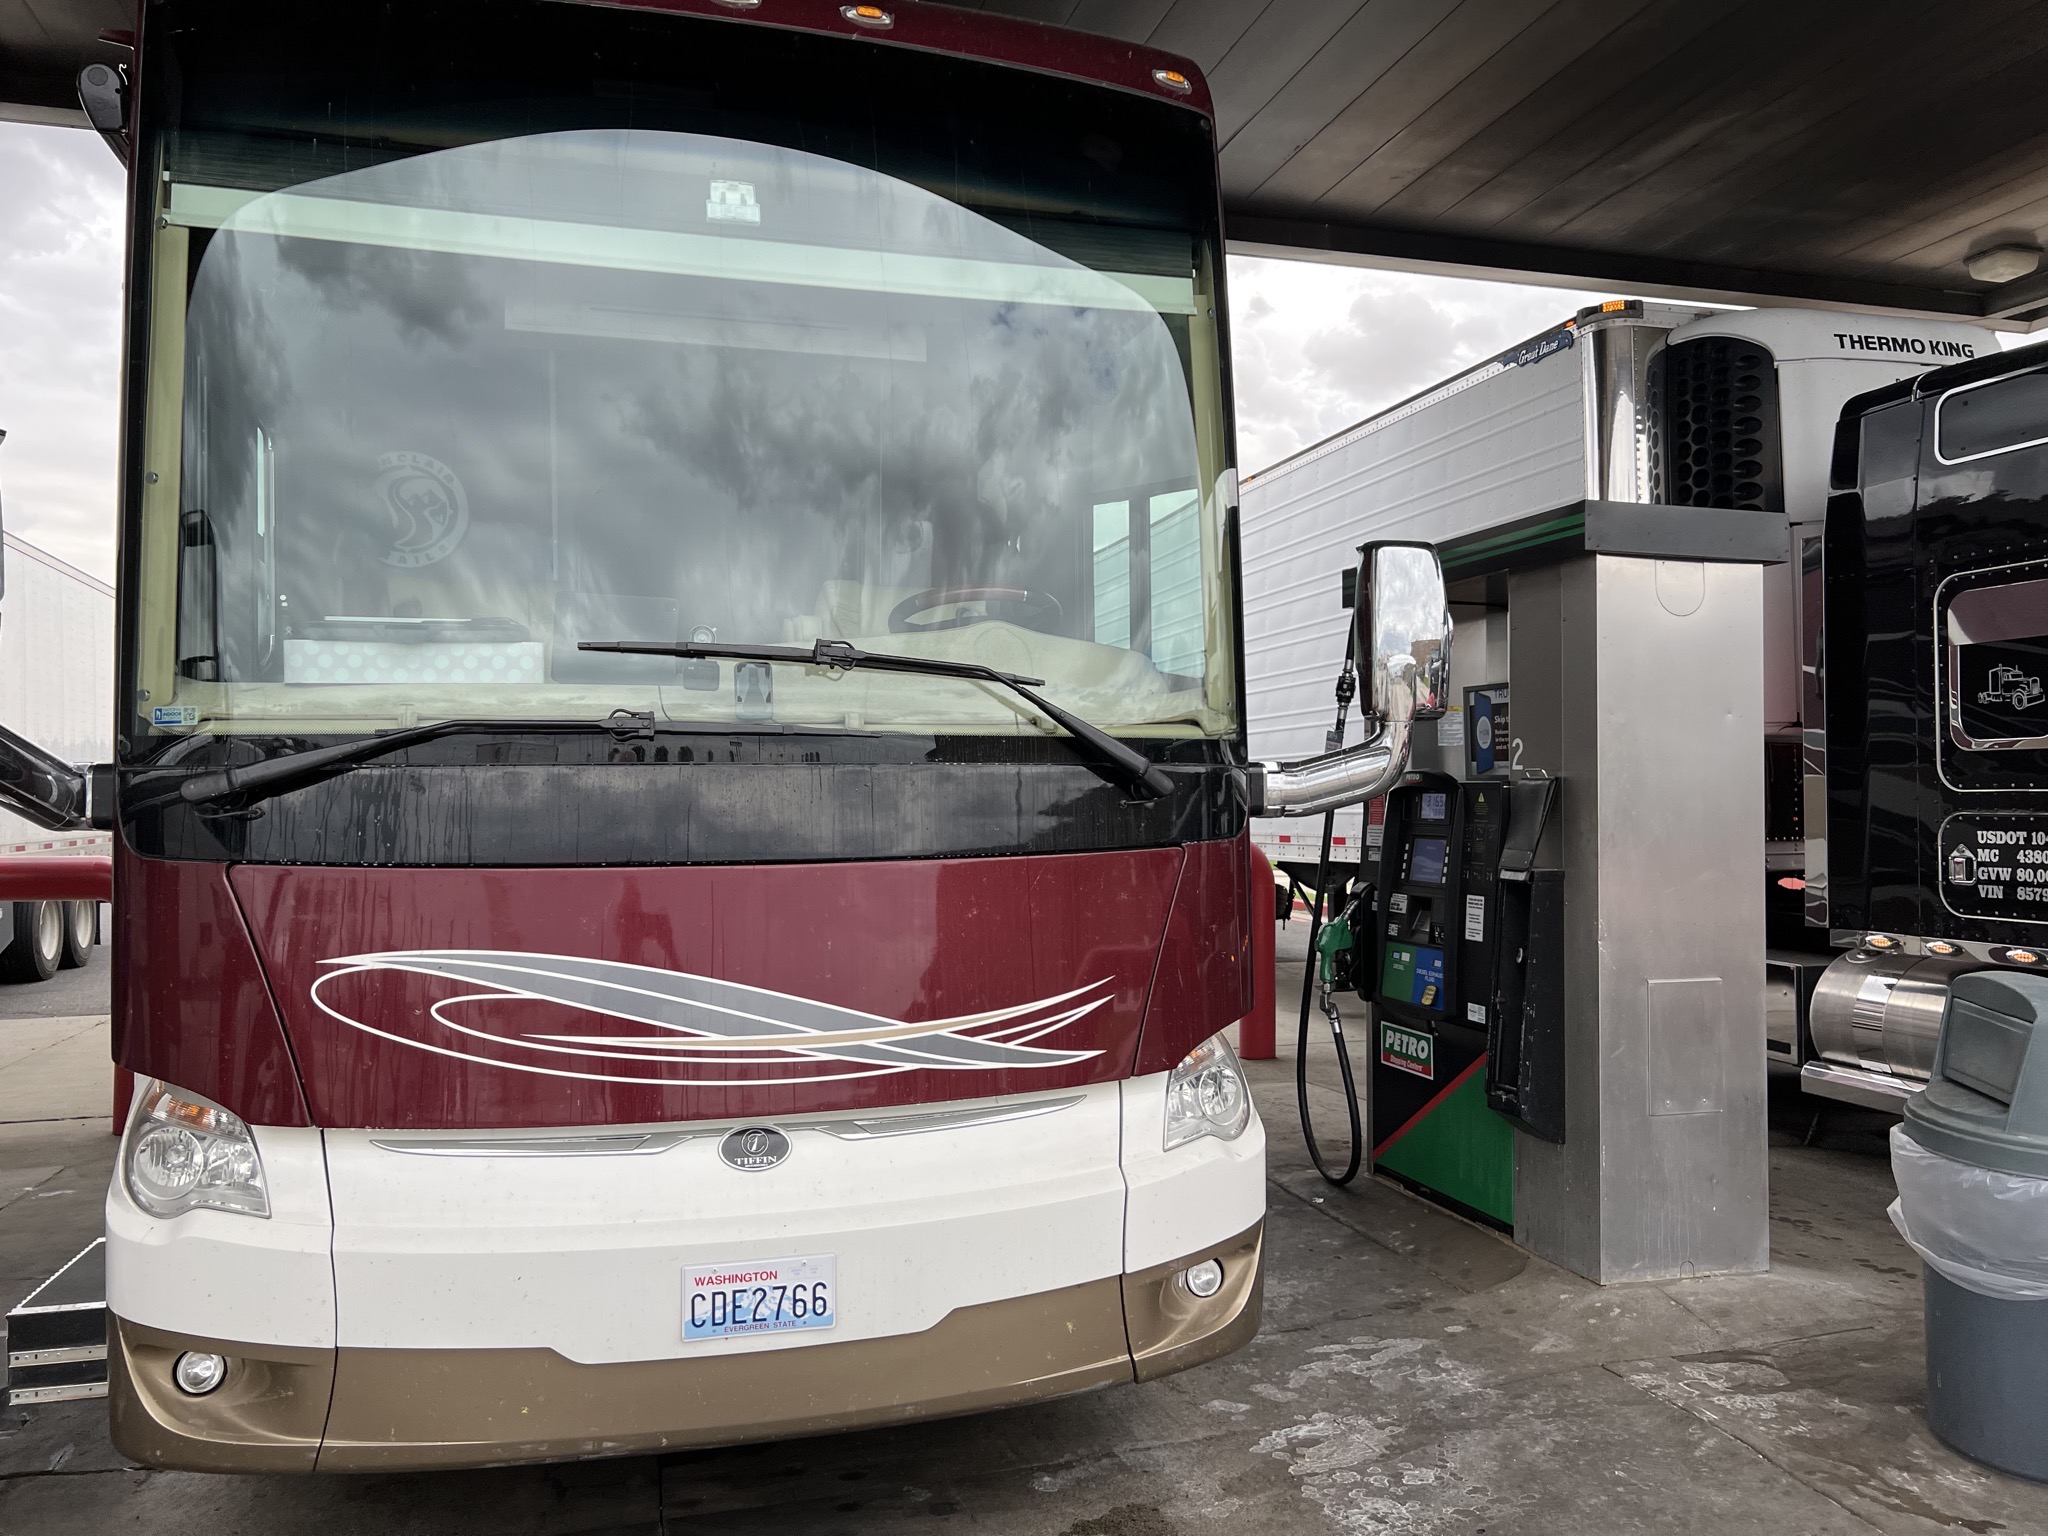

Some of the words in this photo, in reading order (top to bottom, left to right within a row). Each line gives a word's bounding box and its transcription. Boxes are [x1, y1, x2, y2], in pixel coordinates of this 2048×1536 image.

[1518, 347, 1539, 365] Great
[1539, 340, 1559, 356] Dane
[1833, 333, 1926, 355] THERMO
[1928, 340, 1975, 359] KING
[1512, 737, 1524, 771] 2
[1976, 830, 2028, 845] USDOT
[1976, 848, 2000, 863] MC
[1977, 866, 2012, 881] GVW
[1977, 884, 2004, 899] VIN
[1384, 1029, 1429, 1060] PETRO
[733, 1155, 777, 1166] TIFFIN
[694, 1270, 778, 1287] WASHINGTON
[690, 1281, 828, 1329] CDE2766
[724, 1323, 770, 1333] EVERGREEN
[773, 1320, 797, 1329] STATE
